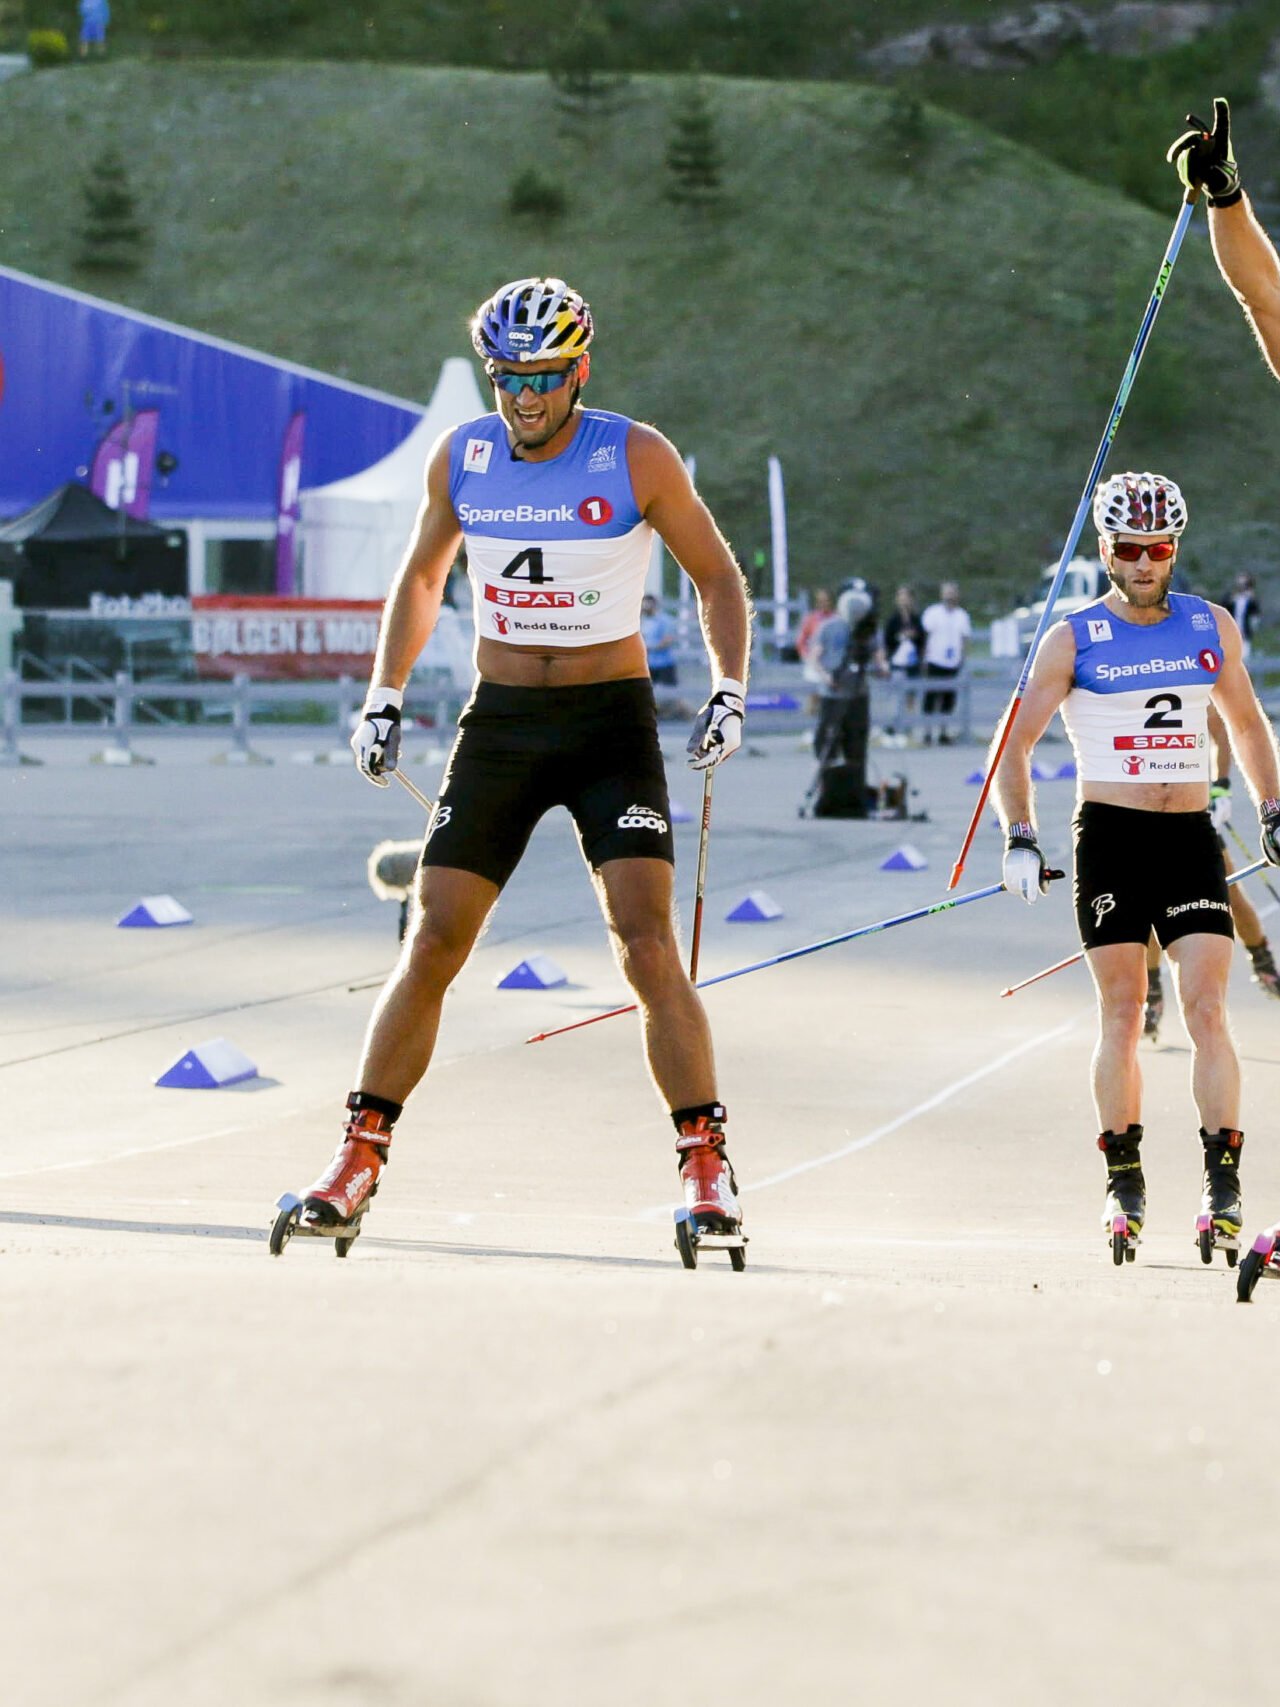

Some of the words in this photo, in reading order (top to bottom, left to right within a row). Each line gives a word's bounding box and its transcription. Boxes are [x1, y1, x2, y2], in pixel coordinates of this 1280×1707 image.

[508, 332, 534, 342] coop
[458, 503, 575, 525] SpareBank
[587, 500, 602, 521] 1
[501, 547, 554, 585] 4
[496, 589, 574, 605] SPAR
[514, 621, 547, 631] Redd
[550, 622, 591, 631] Barna
[1096, 656, 1199, 681] SpareBank
[1203, 652, 1216, 669] 1
[1144, 692, 1183, 729] 2
[1133, 736, 1196, 749] SPAR
[1149, 762, 1177, 770] Redd
[627, 804, 662, 818] team
[617, 815, 668, 834] coop
[1166, 899, 1229, 918] SpareBank
